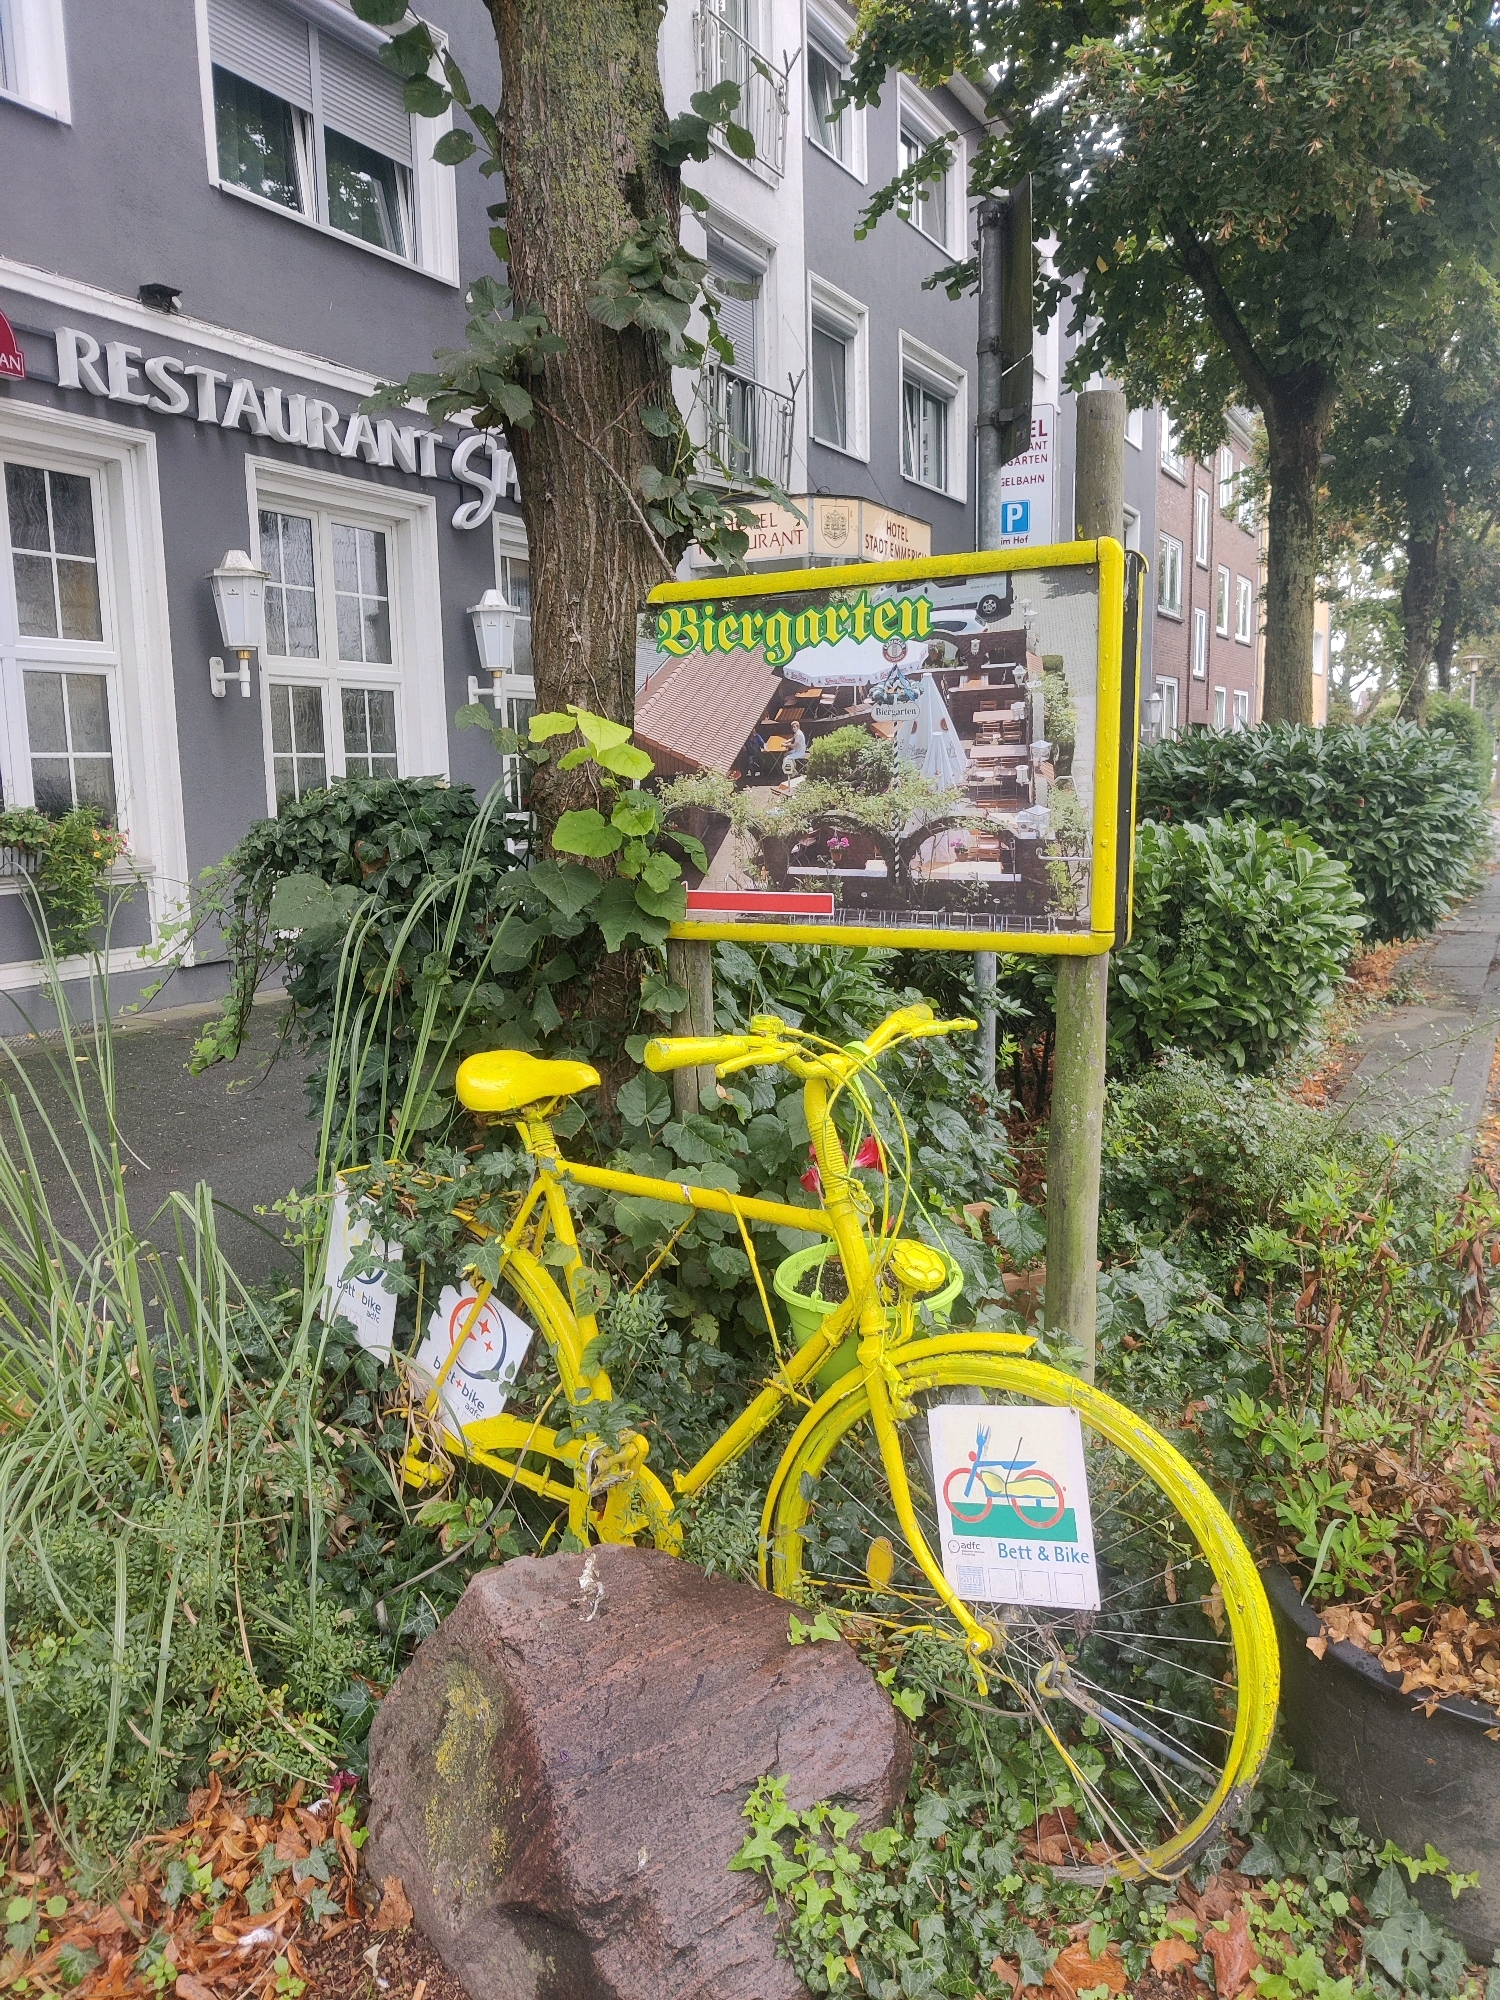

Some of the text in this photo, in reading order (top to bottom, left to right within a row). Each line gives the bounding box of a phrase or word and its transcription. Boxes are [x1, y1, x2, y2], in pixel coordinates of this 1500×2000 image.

[55, 326, 443, 478] RESTAURANT
[1003, 453, 1048, 467] GARTEN
[1001, 474, 1045, 486] GELBAHN
[1006, 503, 1023, 532] P
[886, 520, 909, 543] HOTEL
[1013, 534, 1029, 544] Hof
[865, 533, 928, 561] STADT EMMER
[657, 590, 934, 666] Biergarten
[875, 707, 917, 718] Biergarten
[960, 1541, 981, 1550] adfc
[997, 1542, 1090, 1564] Bett & Bike
